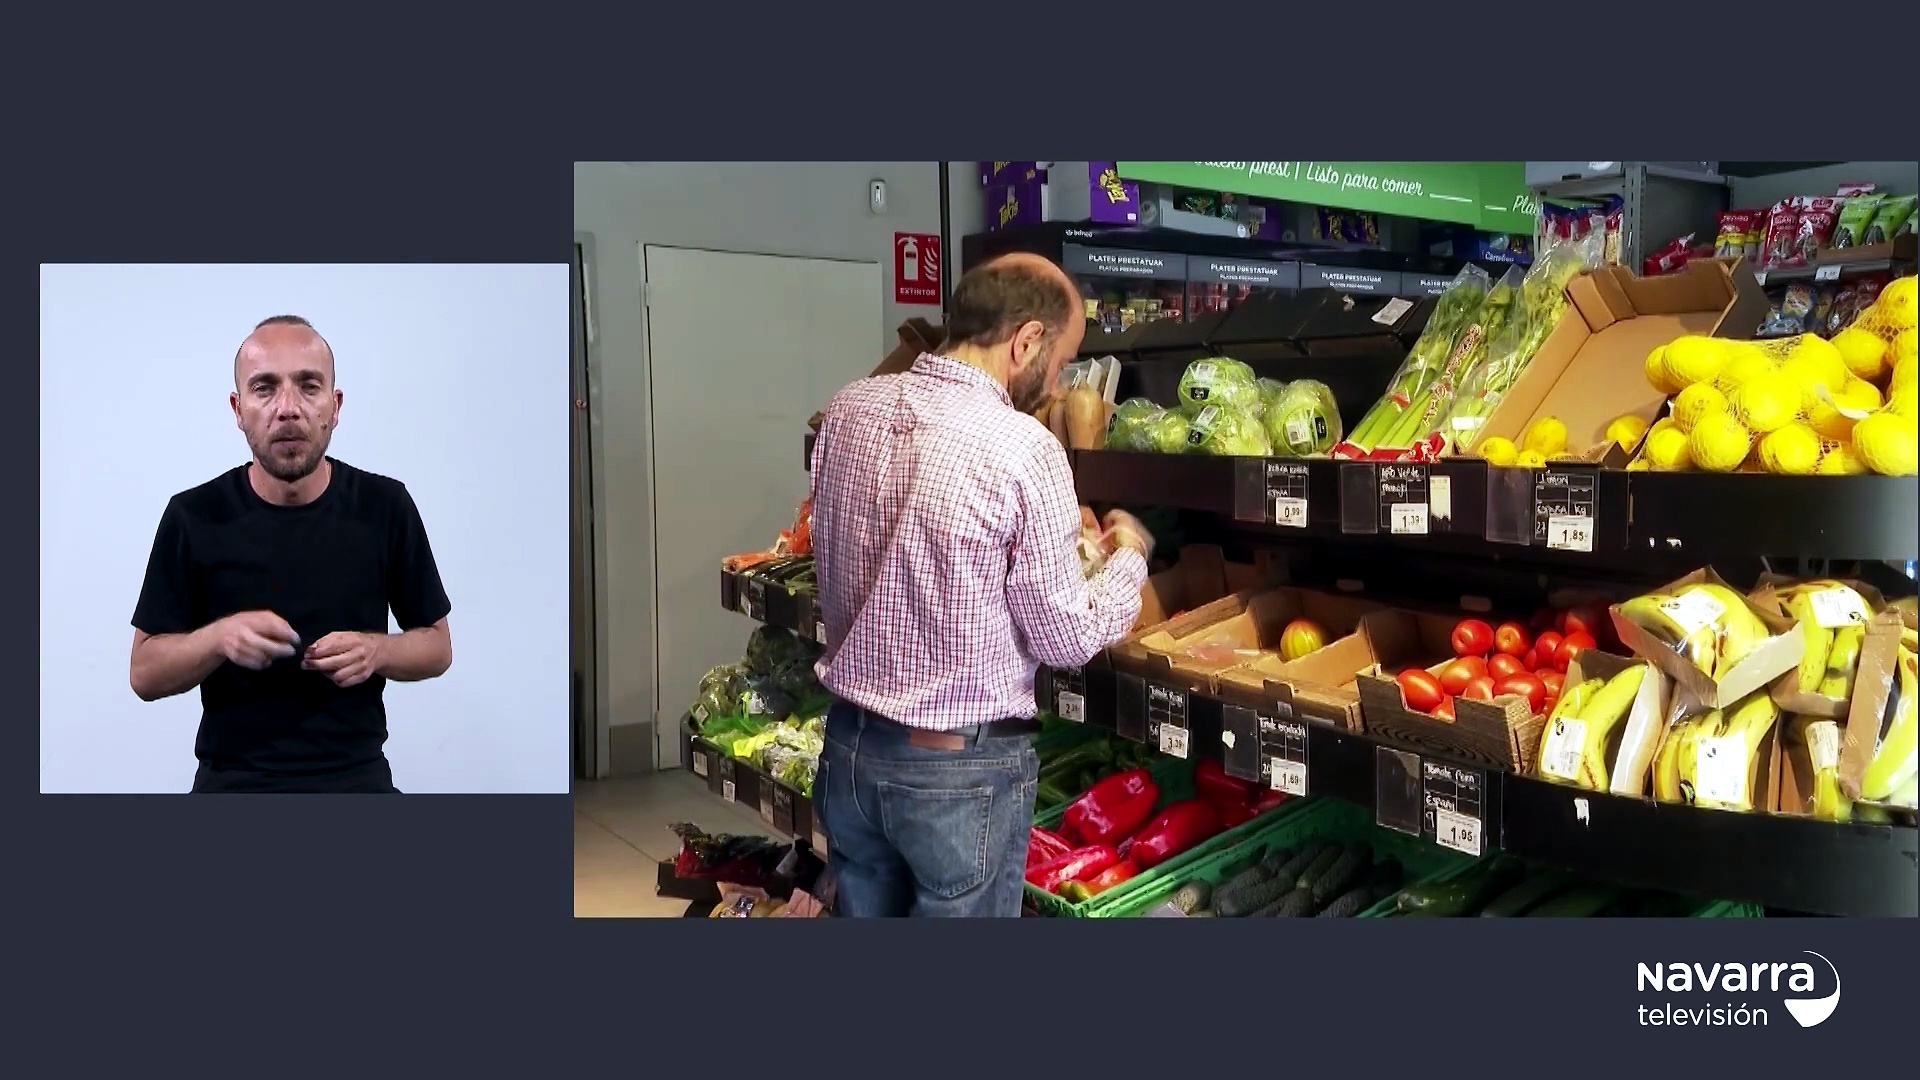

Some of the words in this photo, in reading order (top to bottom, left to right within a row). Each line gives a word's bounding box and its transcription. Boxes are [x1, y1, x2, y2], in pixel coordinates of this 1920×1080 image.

[1306, 161, 1339, 184] Listo
[1341, 171, 1379, 192] para
[1381, 175, 1424, 196] comer
[1512, 195, 1539, 215] Pla
[1088, 253, 1117, 264] PLATER
[1210, 263, 1236, 272] PLATER
[900, 287, 936, 297] EXTINTOR
